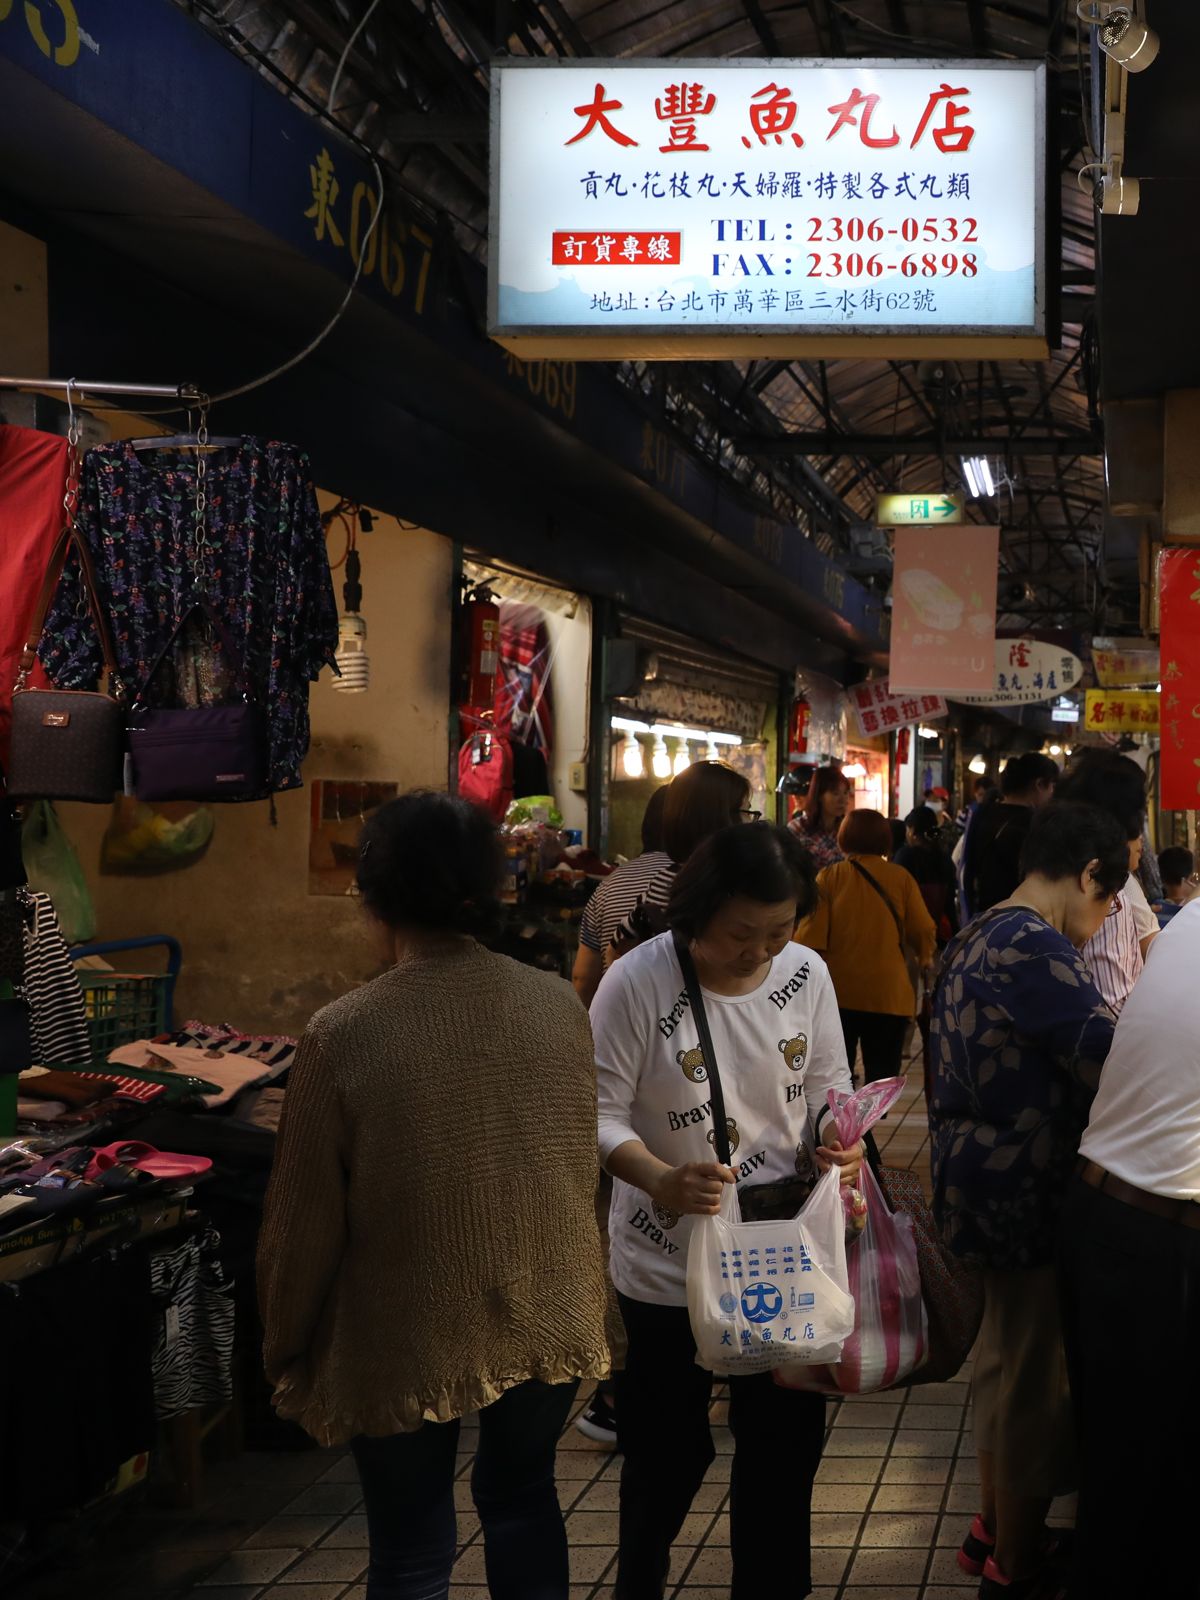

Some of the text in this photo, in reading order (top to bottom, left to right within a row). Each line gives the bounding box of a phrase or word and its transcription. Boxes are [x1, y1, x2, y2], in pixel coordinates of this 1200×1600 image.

[564, 82, 978, 154] 大豐魚丸店
[304, 147, 432, 314] 東067
[561, 235, 675, 263] 訂貨專線
[806, 217, 979, 243] 2306-0532
[806, 252, 979, 278] 2306-6898
[768, 962, 811, 1011] Braw
[628, 1207, 680, 1256] Braw
[719, 1322, 816, 1347] 大豐魚丸店
